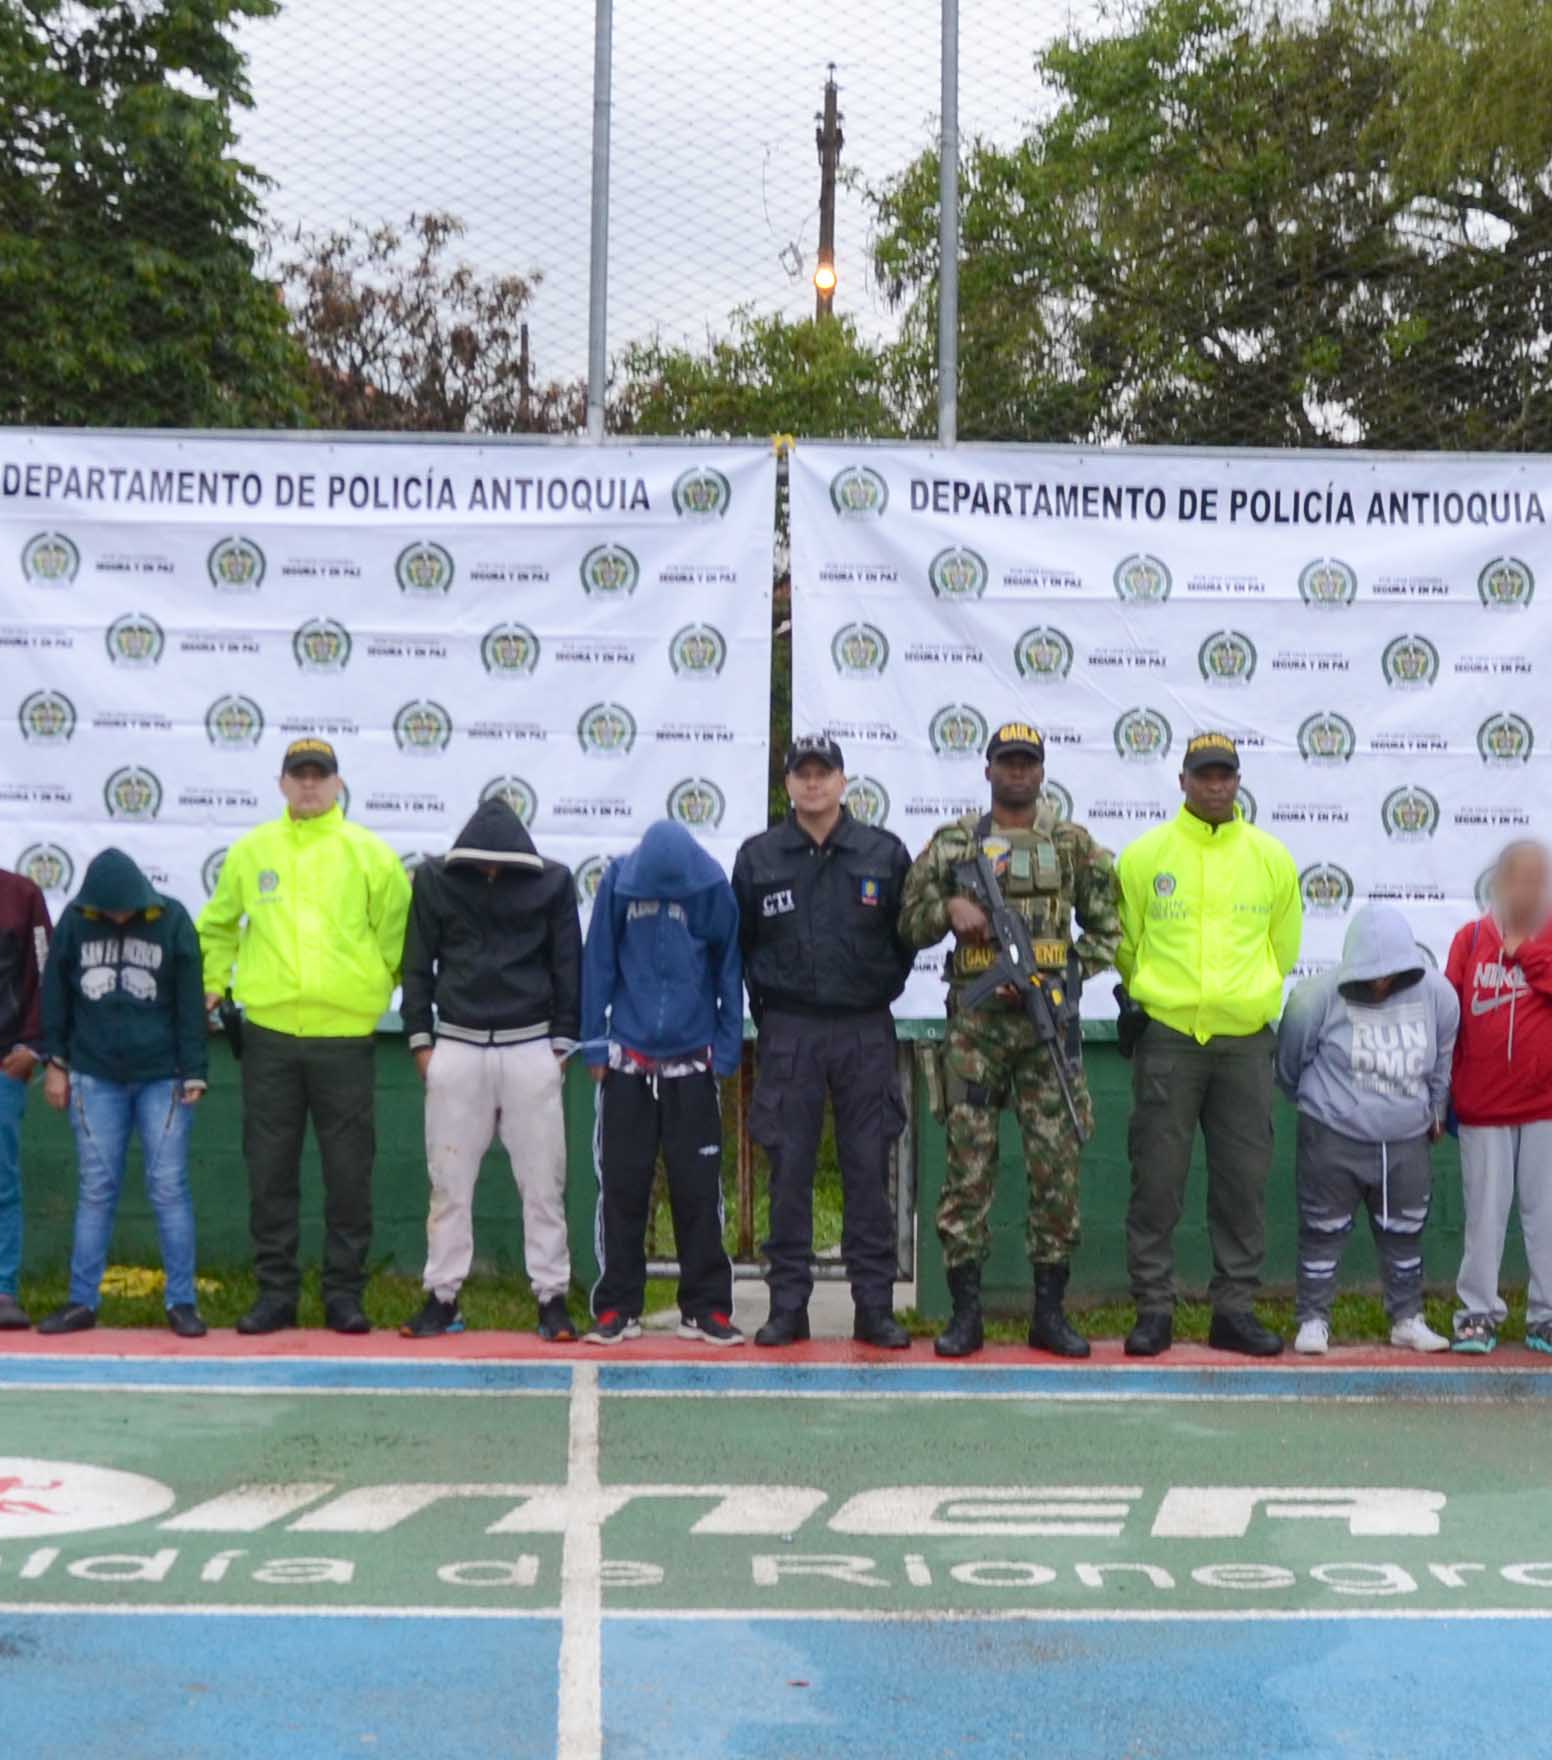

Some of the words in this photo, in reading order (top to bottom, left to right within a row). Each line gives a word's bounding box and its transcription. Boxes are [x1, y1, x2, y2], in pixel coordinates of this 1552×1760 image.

[3, 463, 263, 505] DEPARTAMENTO
[276, 474, 315, 508] DE
[329, 466, 456, 511] POLICÍA
[469, 478, 651, 513] ANTIOQUIA
[910, 479, 1166, 520] DEPARTAMENTO
[1178, 488, 1218, 521] DE
[1230, 482, 1355, 524] POLICÍA
[1366, 491, 1545, 526] ANTIOQUIA
[999, 722, 1041, 746] GAULA
[762, 889, 795, 917] CTI
[1352, 1020, 1429, 1050] RUN
[1351, 1050, 1427, 1078] DMC
[436, 1553, 665, 1588] de
